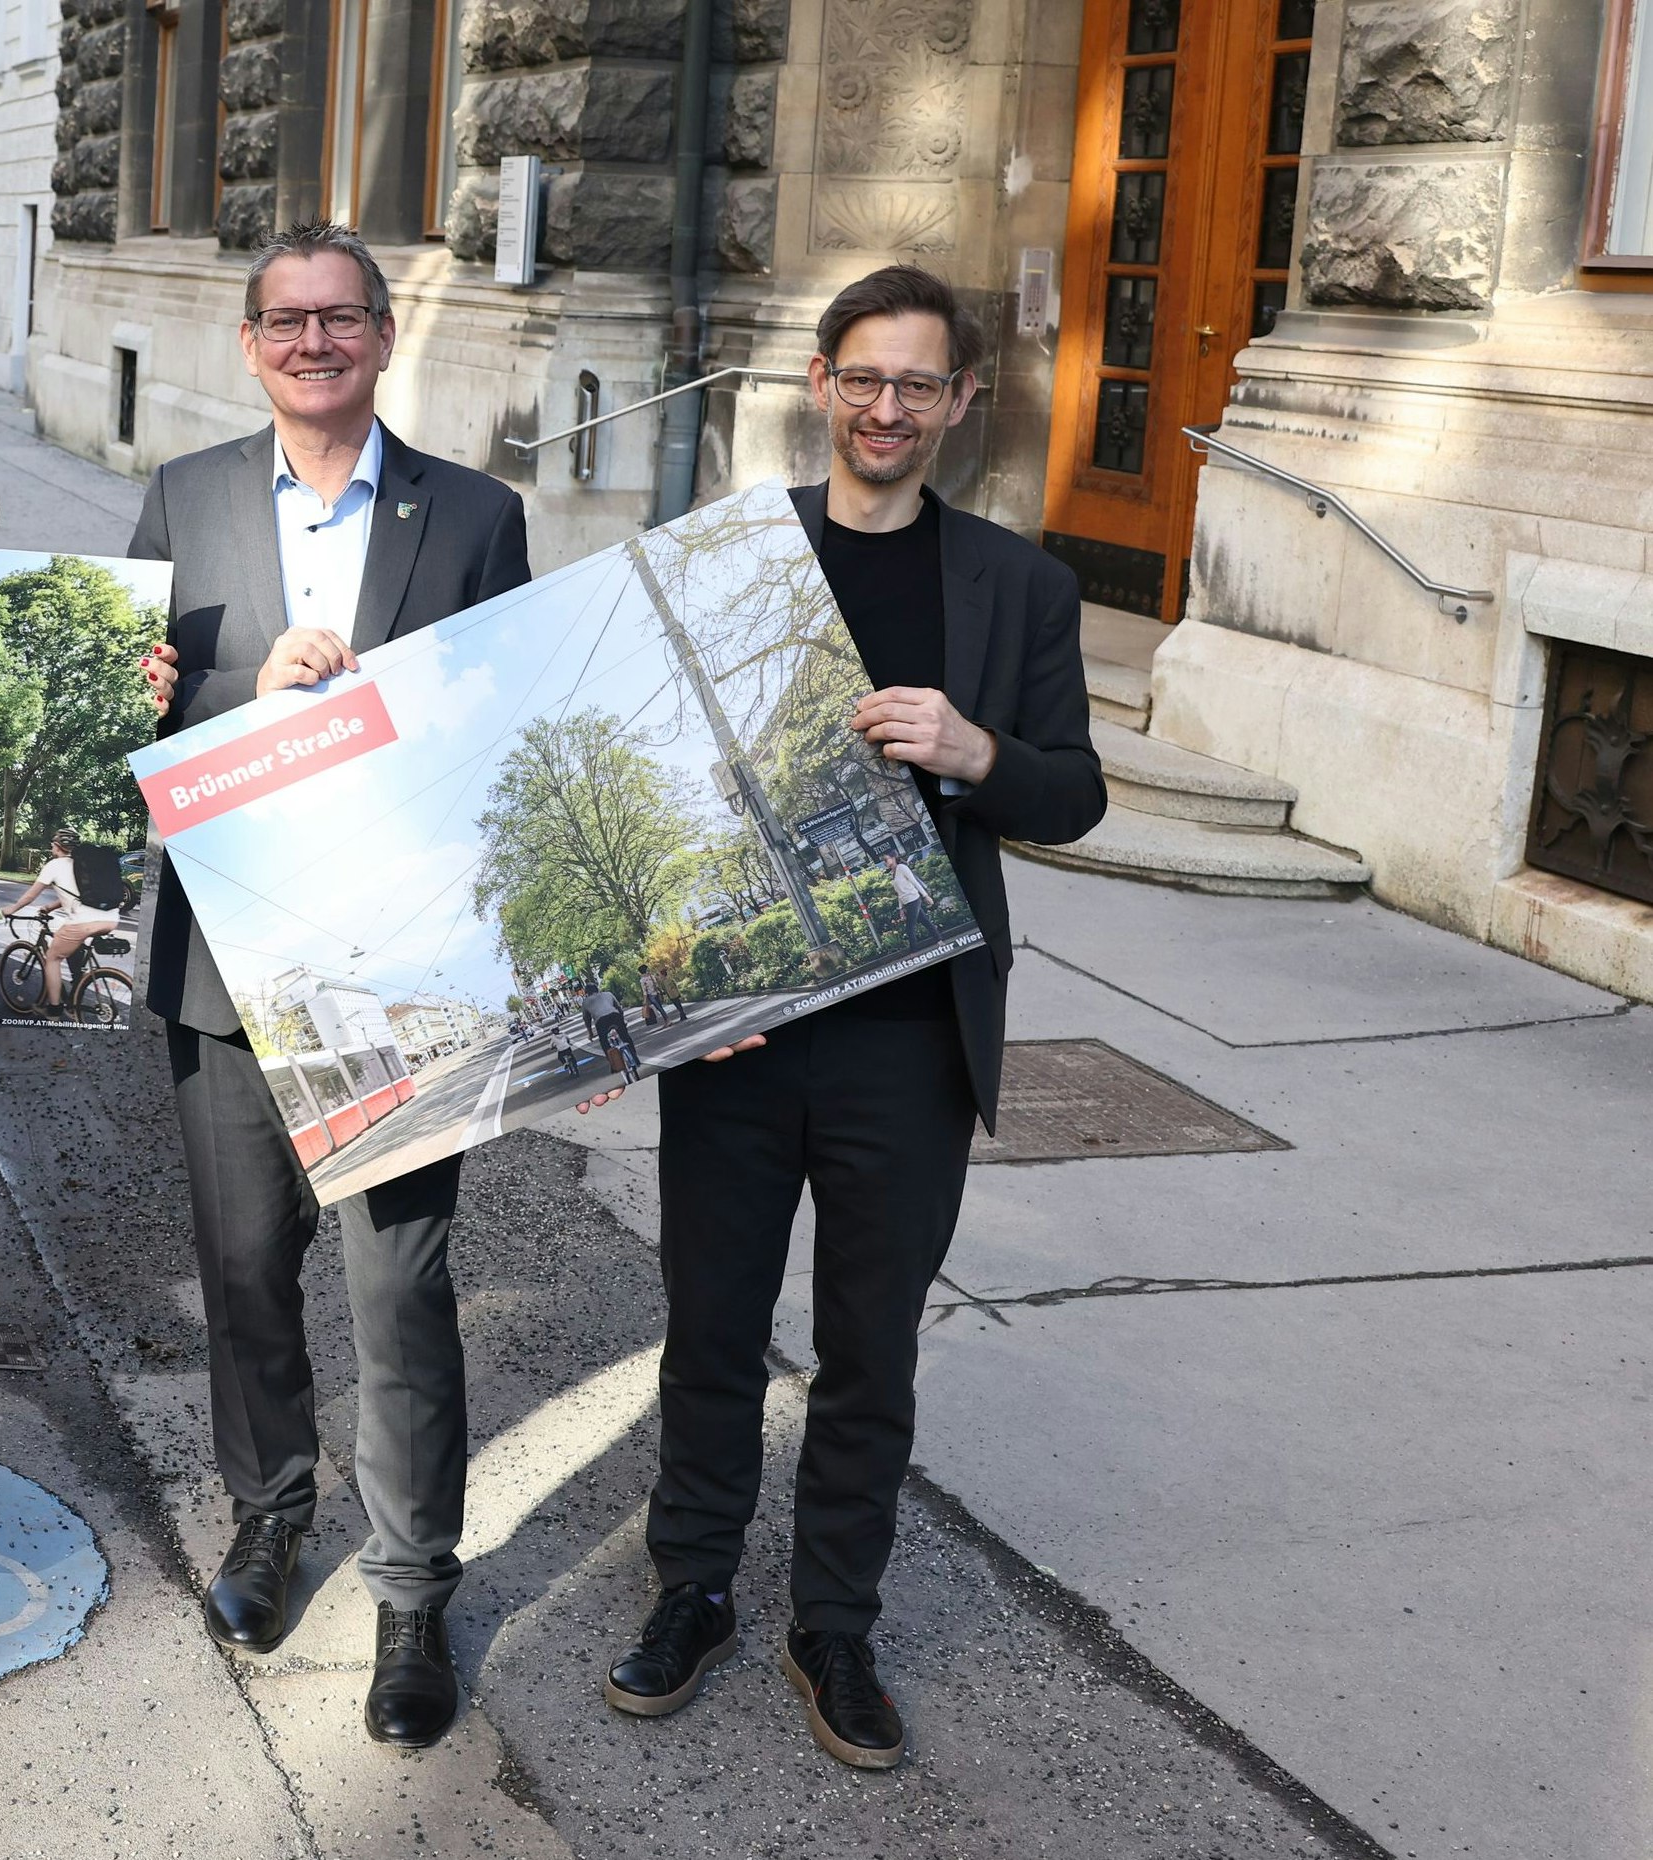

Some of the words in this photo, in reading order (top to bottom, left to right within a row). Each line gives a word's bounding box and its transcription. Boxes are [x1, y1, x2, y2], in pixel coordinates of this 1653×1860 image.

[169, 753, 274, 810] Brünner
[276, 717, 365, 765] Straße
[793, 942, 955, 1012] ZOOMVP.AT/Mobilitätsagentur
